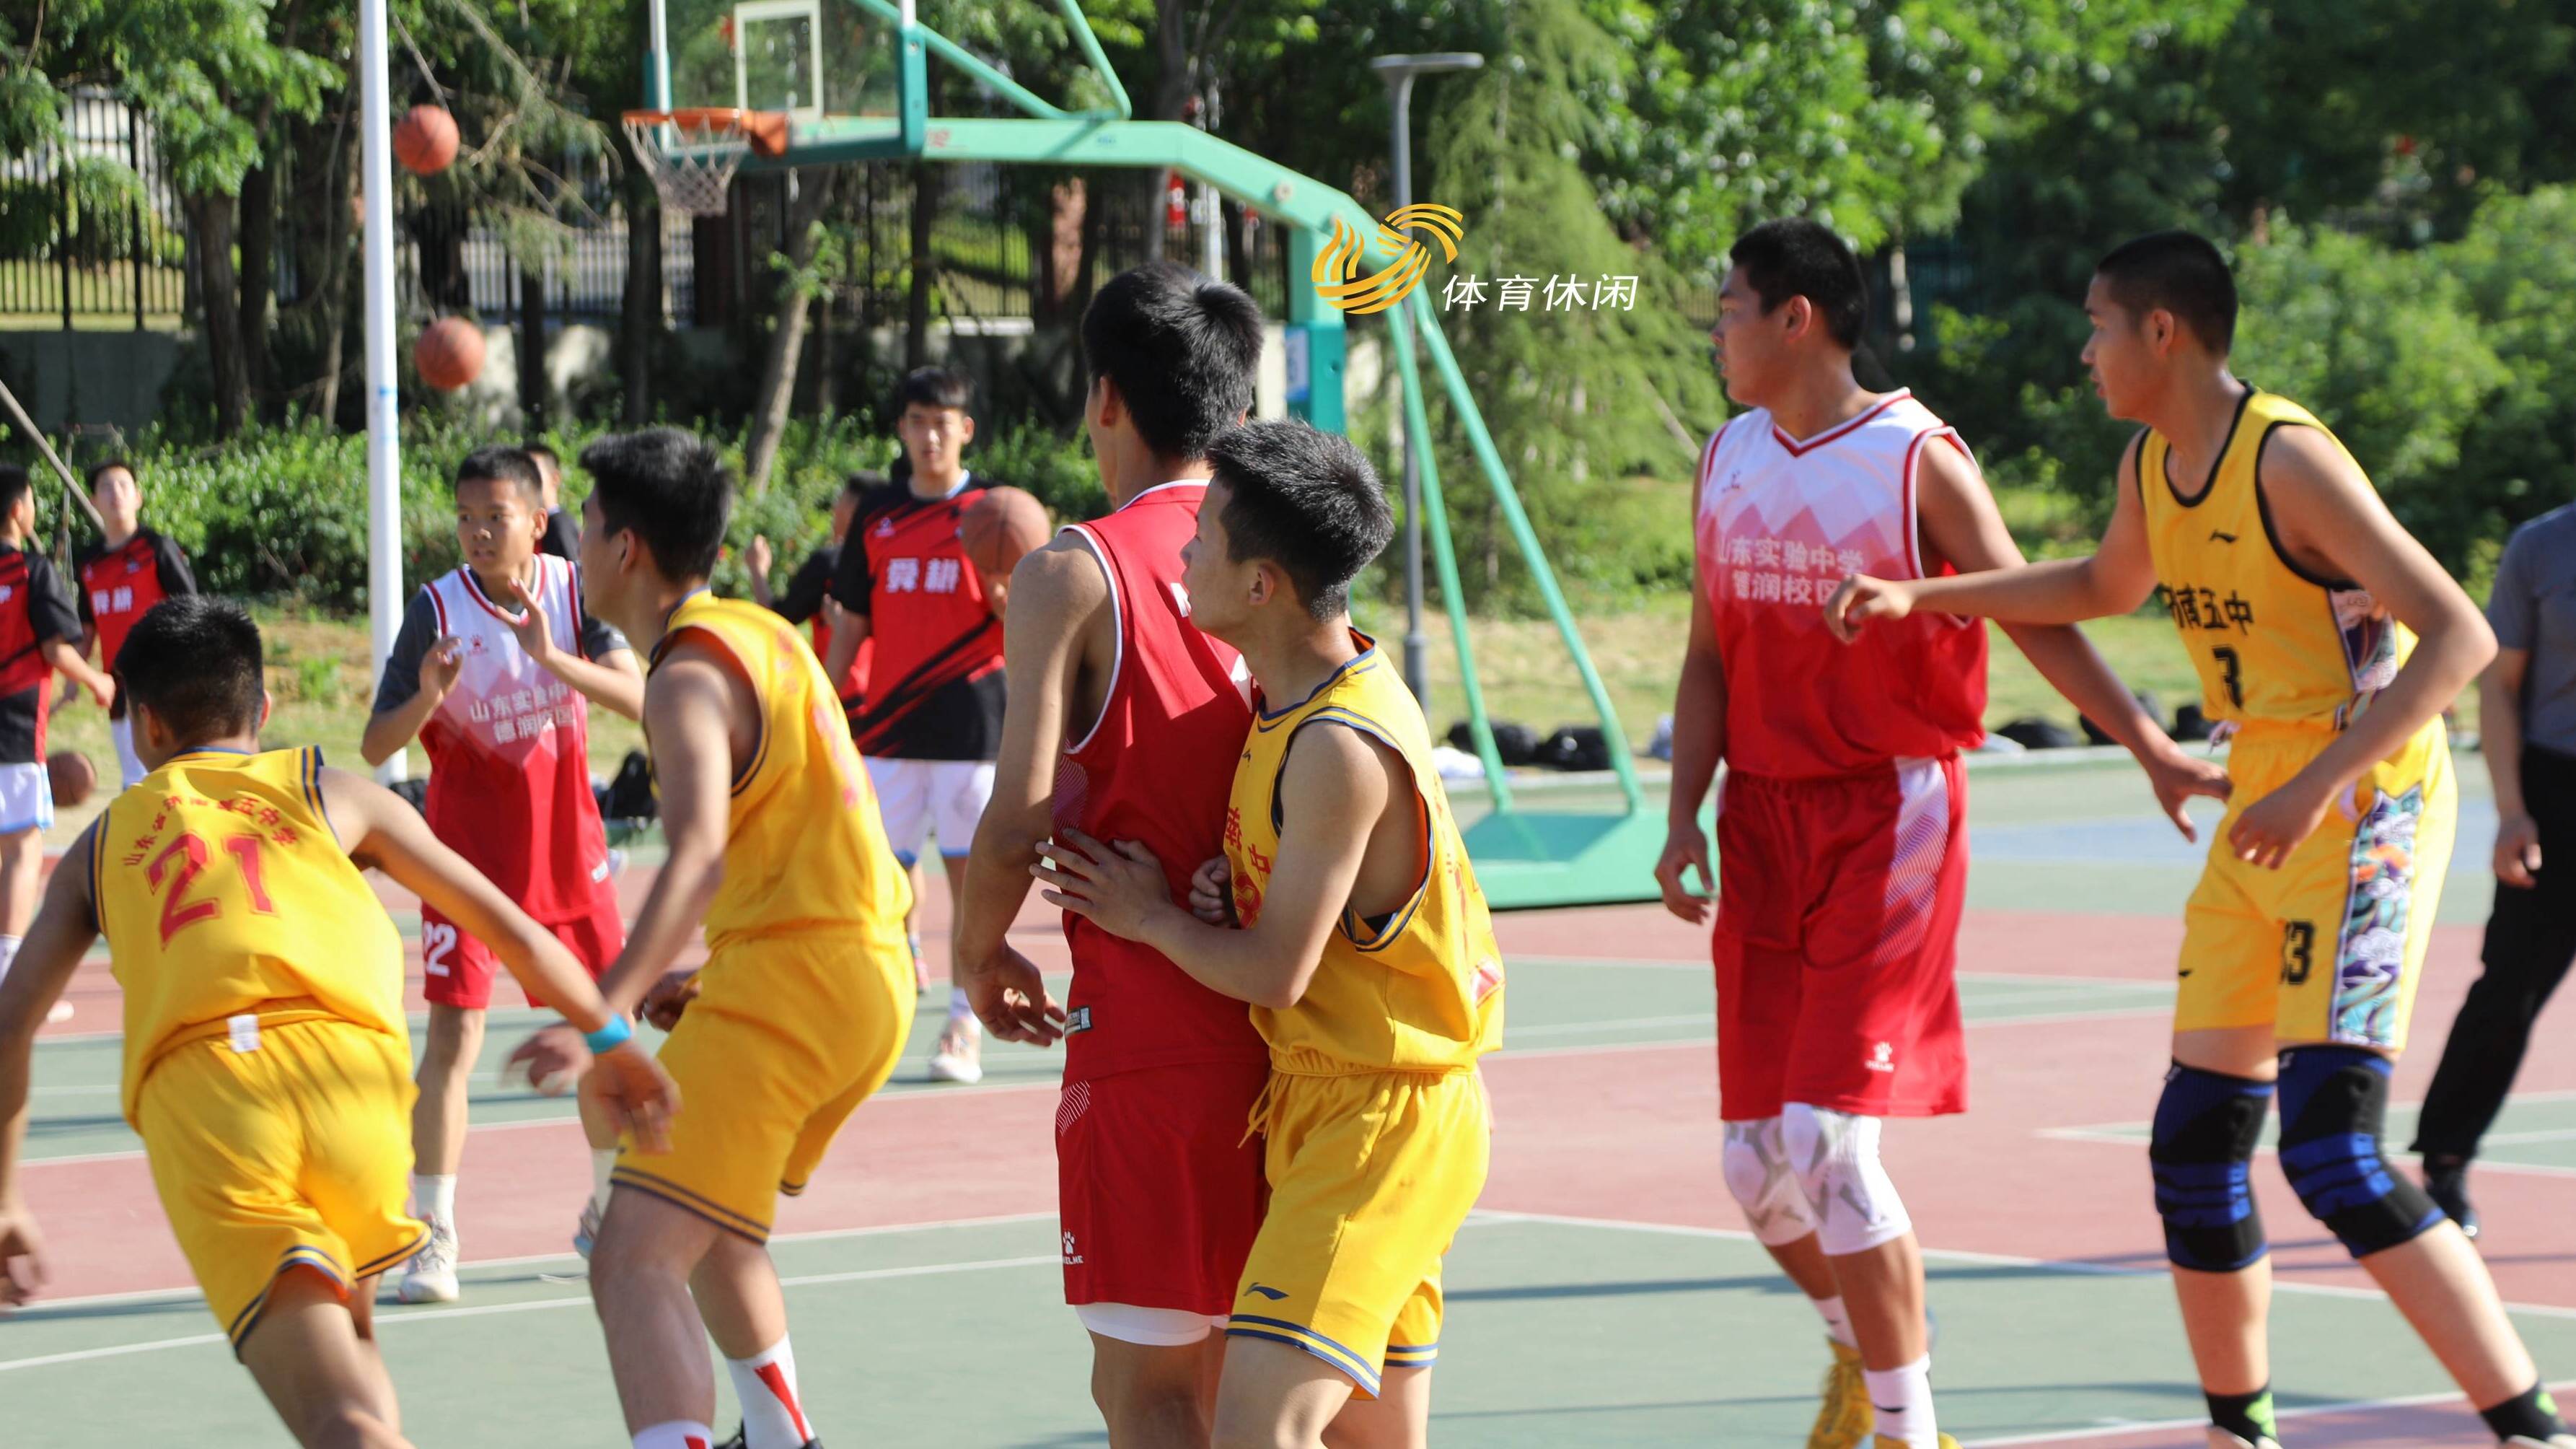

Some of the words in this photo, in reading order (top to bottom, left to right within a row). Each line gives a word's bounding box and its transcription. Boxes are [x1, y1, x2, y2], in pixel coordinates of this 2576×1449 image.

[1716, 535, 1864, 577] 山东实验中学
[144, 830, 278, 951] 21
[2281, 921, 2313, 984] 3
